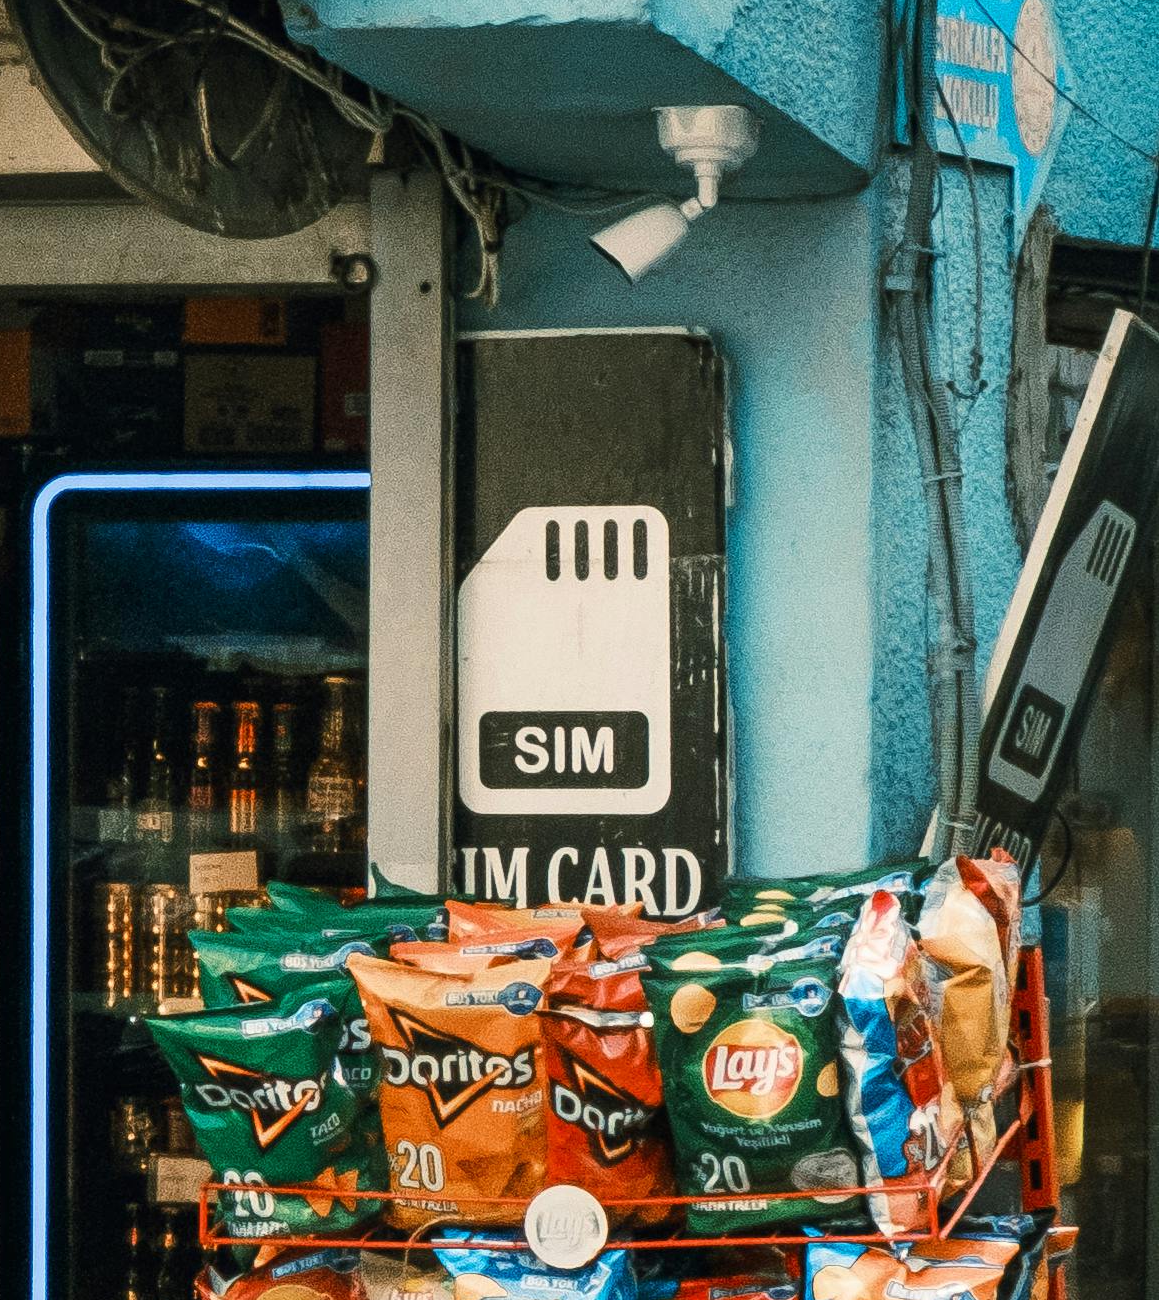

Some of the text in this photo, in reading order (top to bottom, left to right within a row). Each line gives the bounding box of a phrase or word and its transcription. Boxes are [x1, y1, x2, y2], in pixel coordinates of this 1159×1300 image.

[514, 725, 615, 775] SIM
[1015, 704, 1053, 759] SIM
[463, 846, 703, 916] IM CARD
[381, 1048, 534, 1087] Doritos
